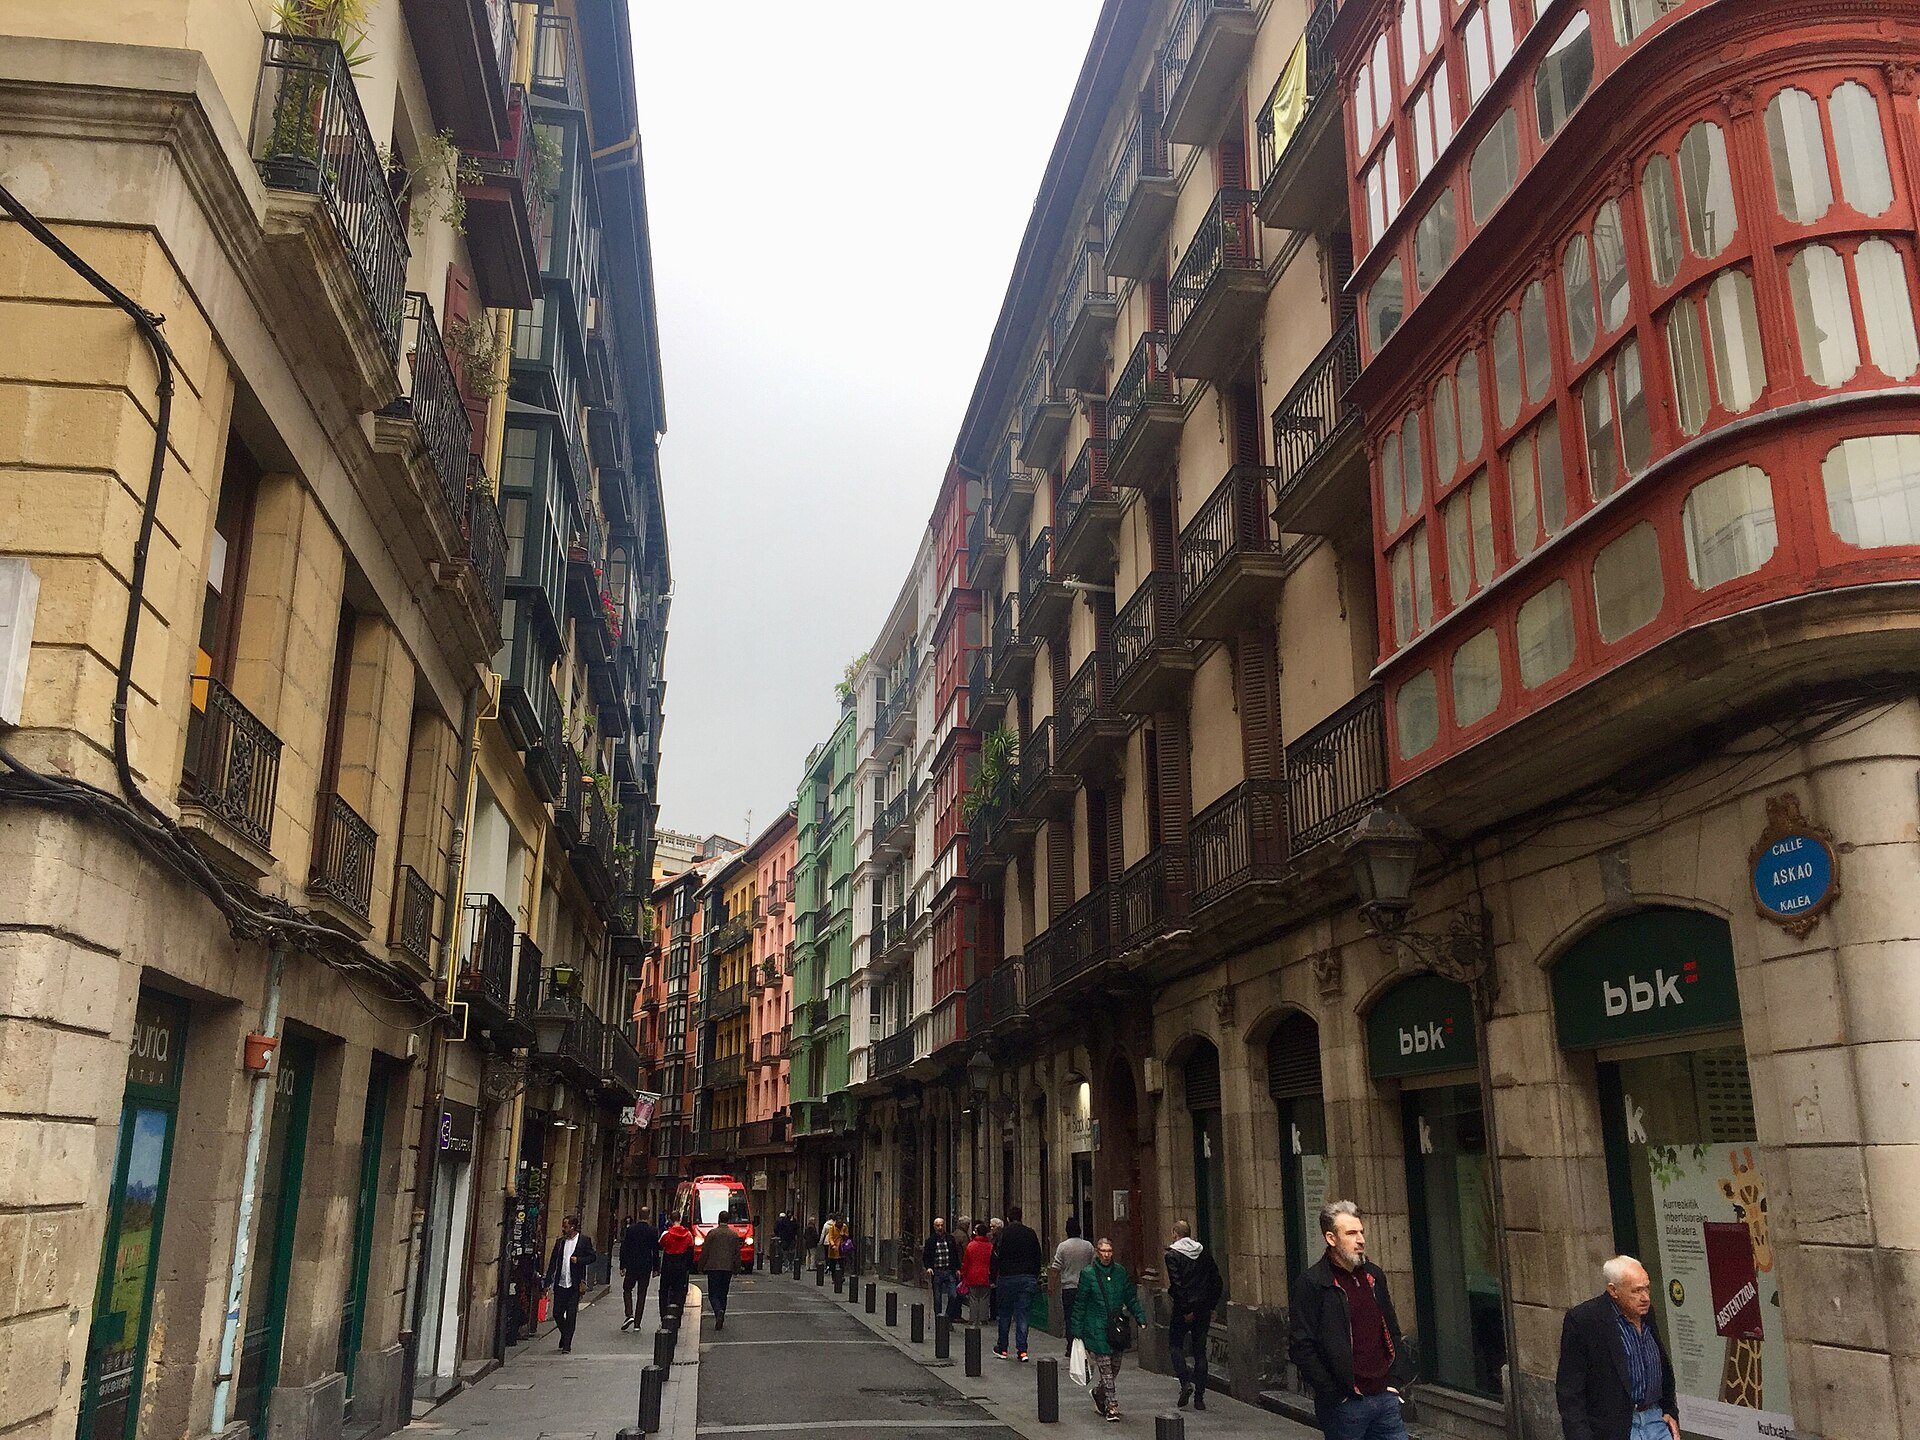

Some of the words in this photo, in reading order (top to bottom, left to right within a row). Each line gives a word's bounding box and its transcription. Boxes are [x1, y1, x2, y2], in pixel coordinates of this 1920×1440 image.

[1772, 838, 1803, 856] CALLE
[1773, 862, 1812, 887] ASKAO
[1780, 895, 1811, 911] KALEA
[1603, 969, 1684, 1017] bbk
[1399, 1021, 1446, 1056] bbk
